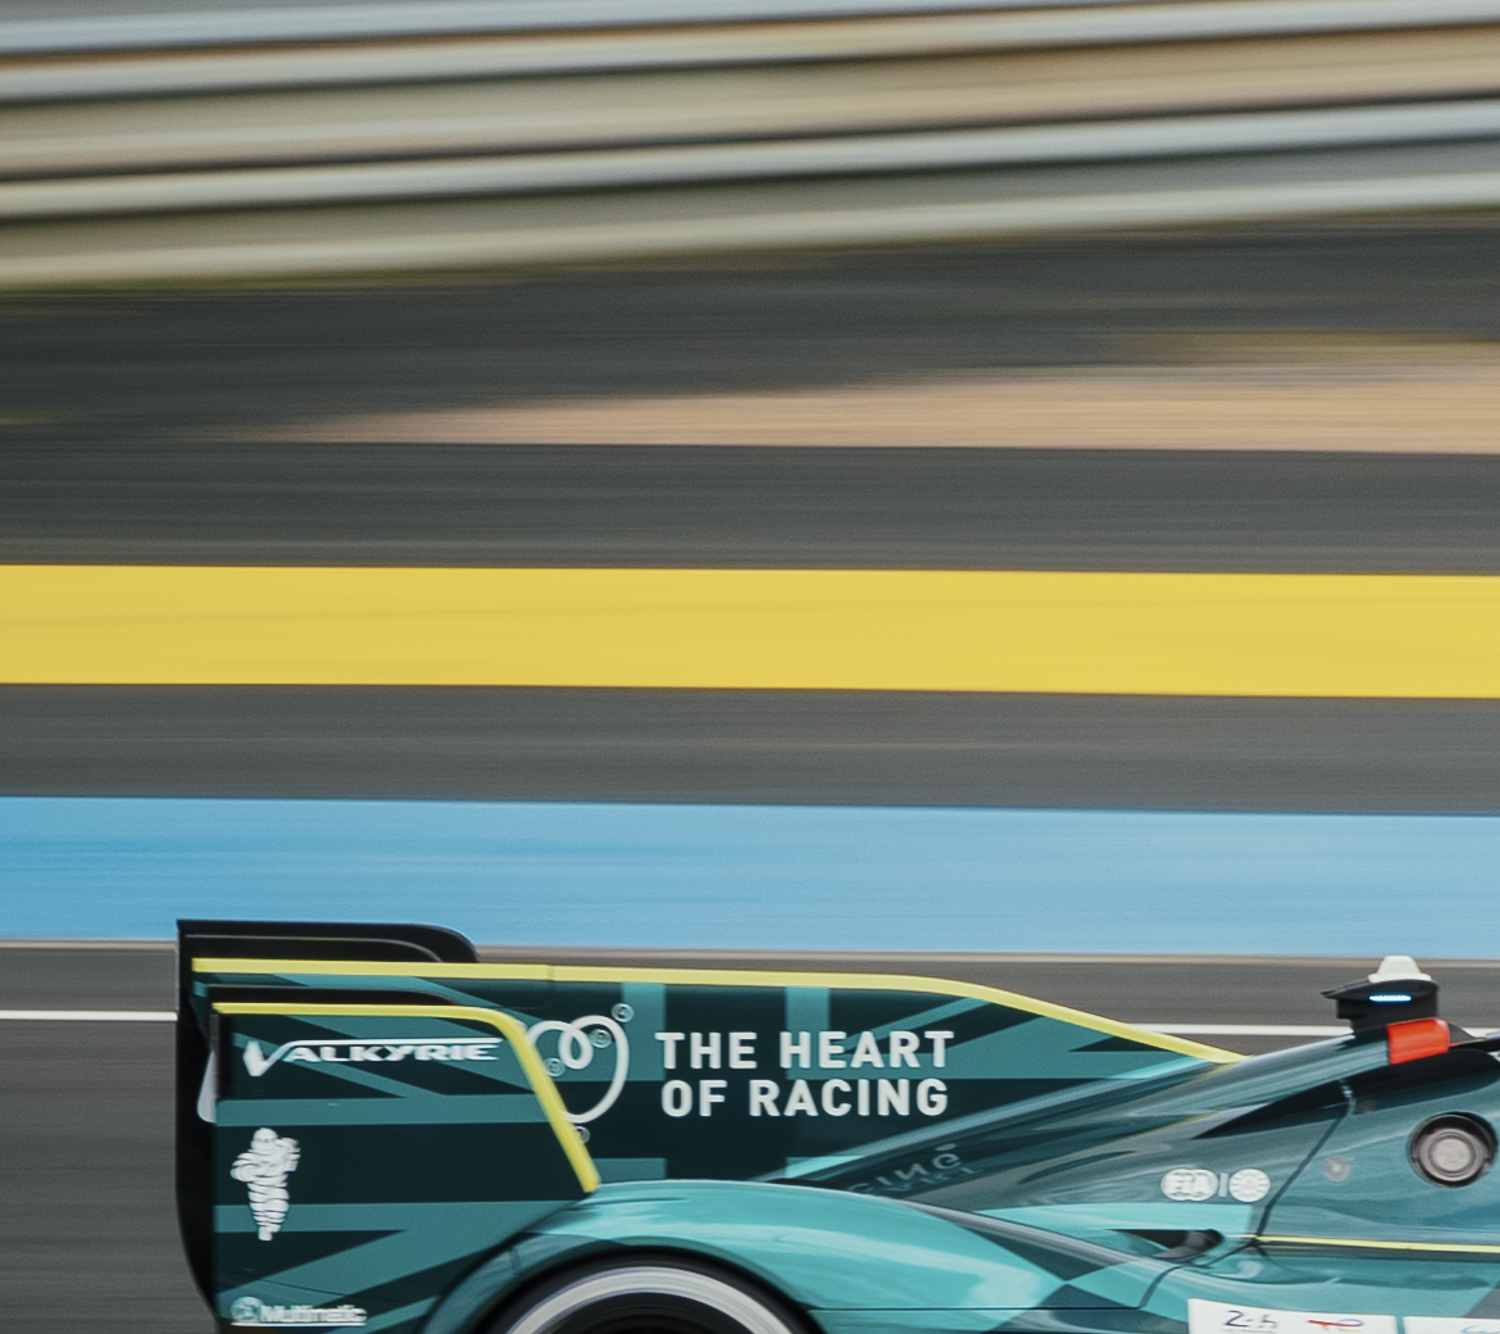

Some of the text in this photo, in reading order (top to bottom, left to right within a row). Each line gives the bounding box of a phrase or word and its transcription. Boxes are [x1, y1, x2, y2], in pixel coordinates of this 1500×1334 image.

[242, 1037, 503, 1077] VALKYRIE
[655, 1030, 955, 1069] THE HEART
[661, 1078, 948, 1118] OF RACING
